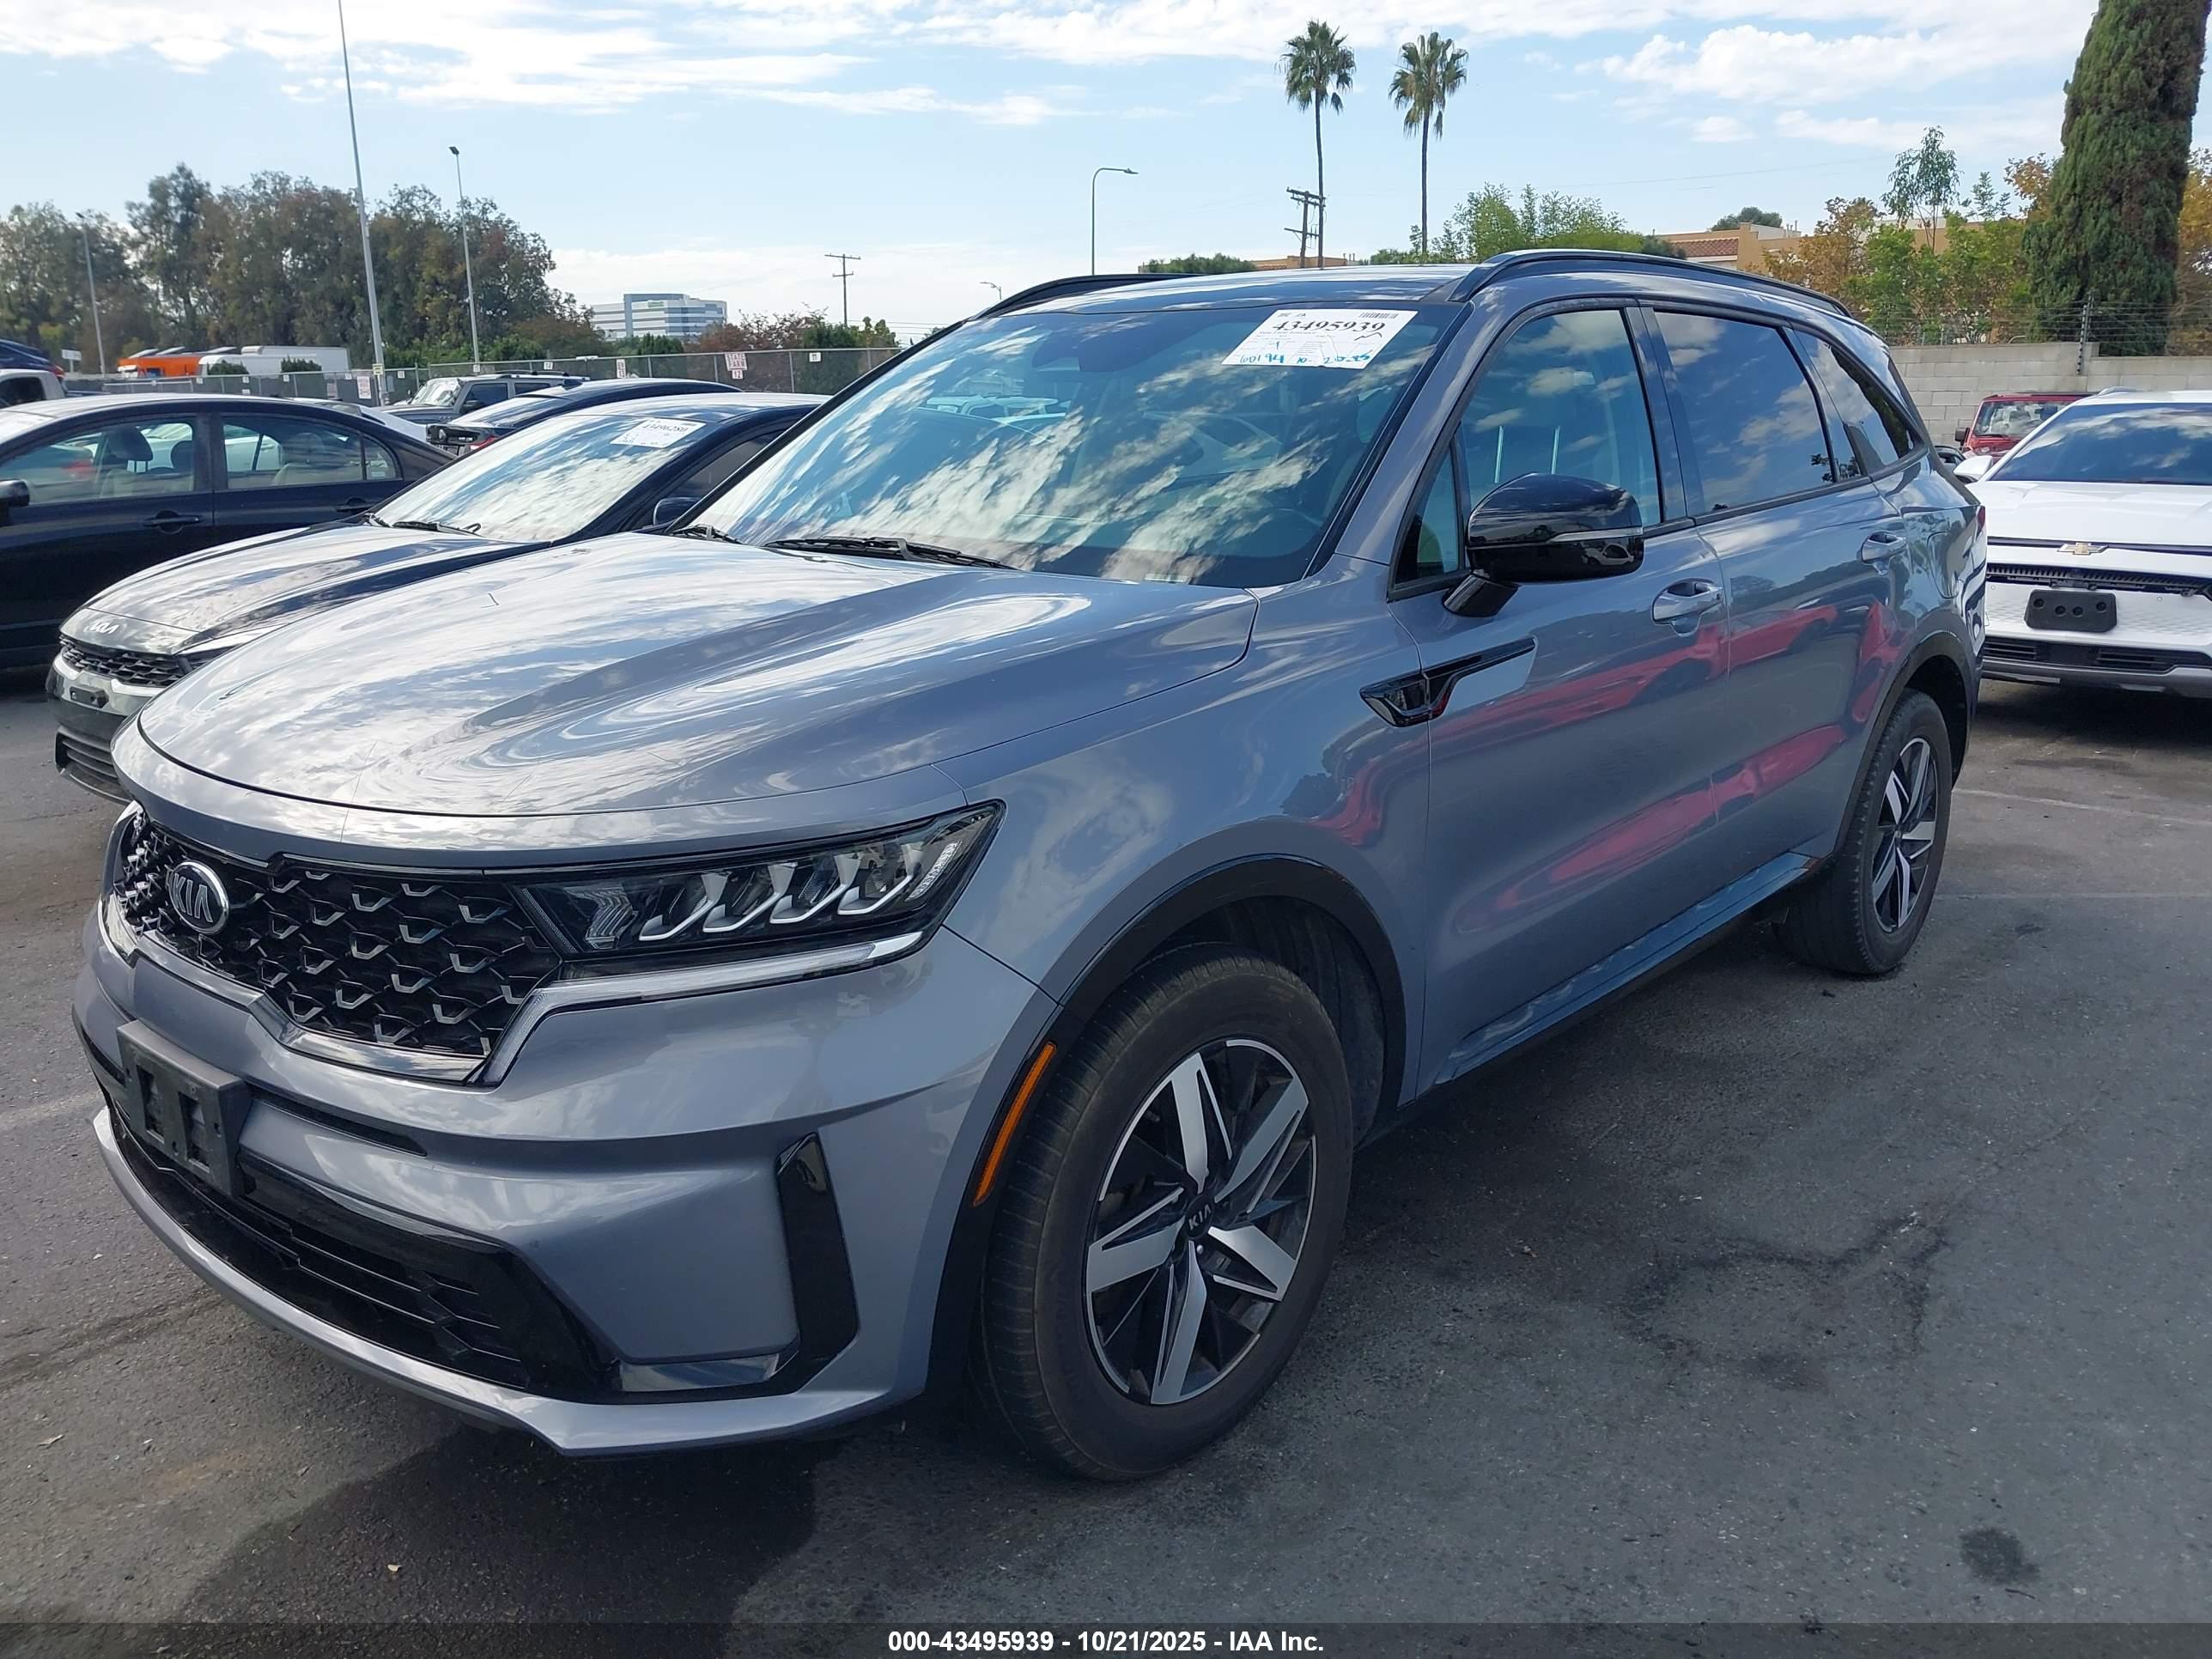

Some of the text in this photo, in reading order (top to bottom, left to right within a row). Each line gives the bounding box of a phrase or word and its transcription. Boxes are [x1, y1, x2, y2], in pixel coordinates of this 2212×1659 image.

[1273, 320, 1385, 332] 43495939
[733, 370, 742, 379] 12
[173, 872, 213, 922] KIA
[1188, 1204, 1211, 1230] KIA
